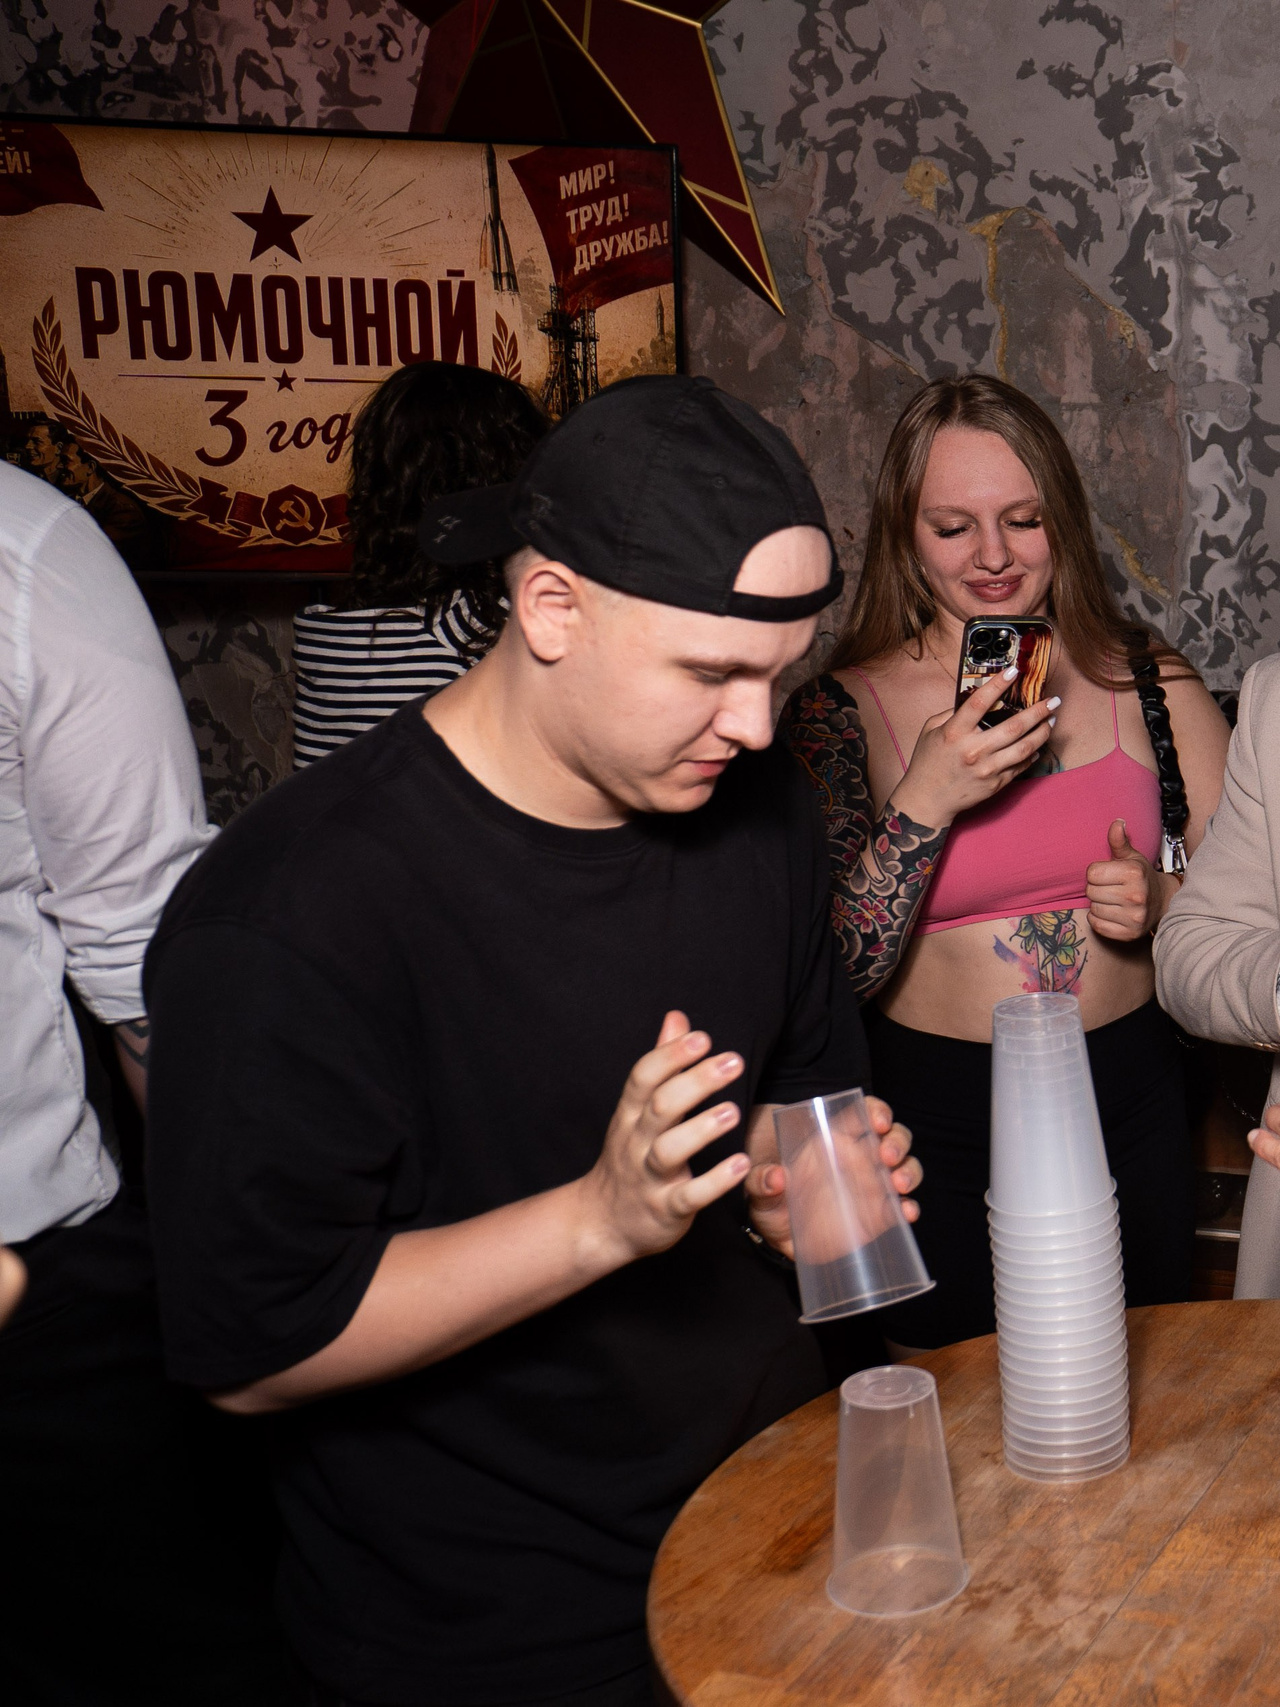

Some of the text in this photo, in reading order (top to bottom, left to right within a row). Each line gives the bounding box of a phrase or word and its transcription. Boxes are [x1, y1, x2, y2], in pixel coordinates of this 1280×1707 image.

[559, 160, 615, 200] МИР!
[565, 193, 629, 234] ТРУД!
[573, 220, 669, 276] ДРУЖБА!
[75, 266, 480, 367] РЮМОЧНОЙ
[195, 389, 353, 467] 3 год
